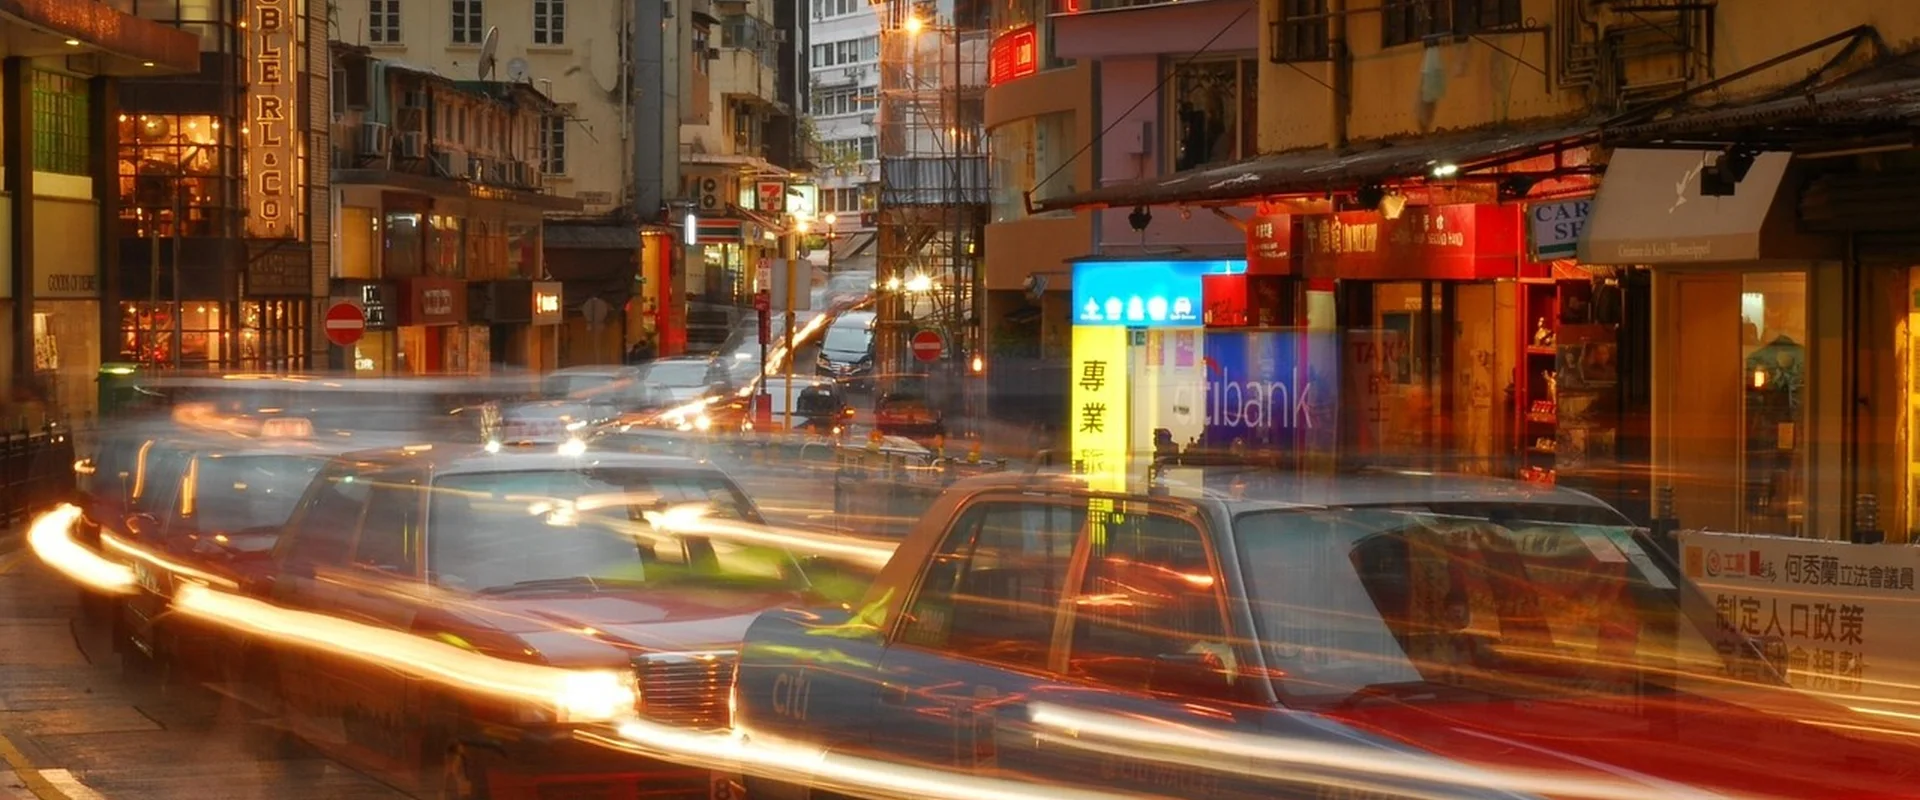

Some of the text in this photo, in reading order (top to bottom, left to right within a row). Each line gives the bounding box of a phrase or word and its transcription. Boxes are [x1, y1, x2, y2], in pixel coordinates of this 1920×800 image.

[1174, 366, 1314, 429] citibank
[1784, 554, 1915, 591] 何秀蘭立法會議員
[1715, 593, 1865, 646] 制定人口政策
[772, 667, 811, 721] citi
